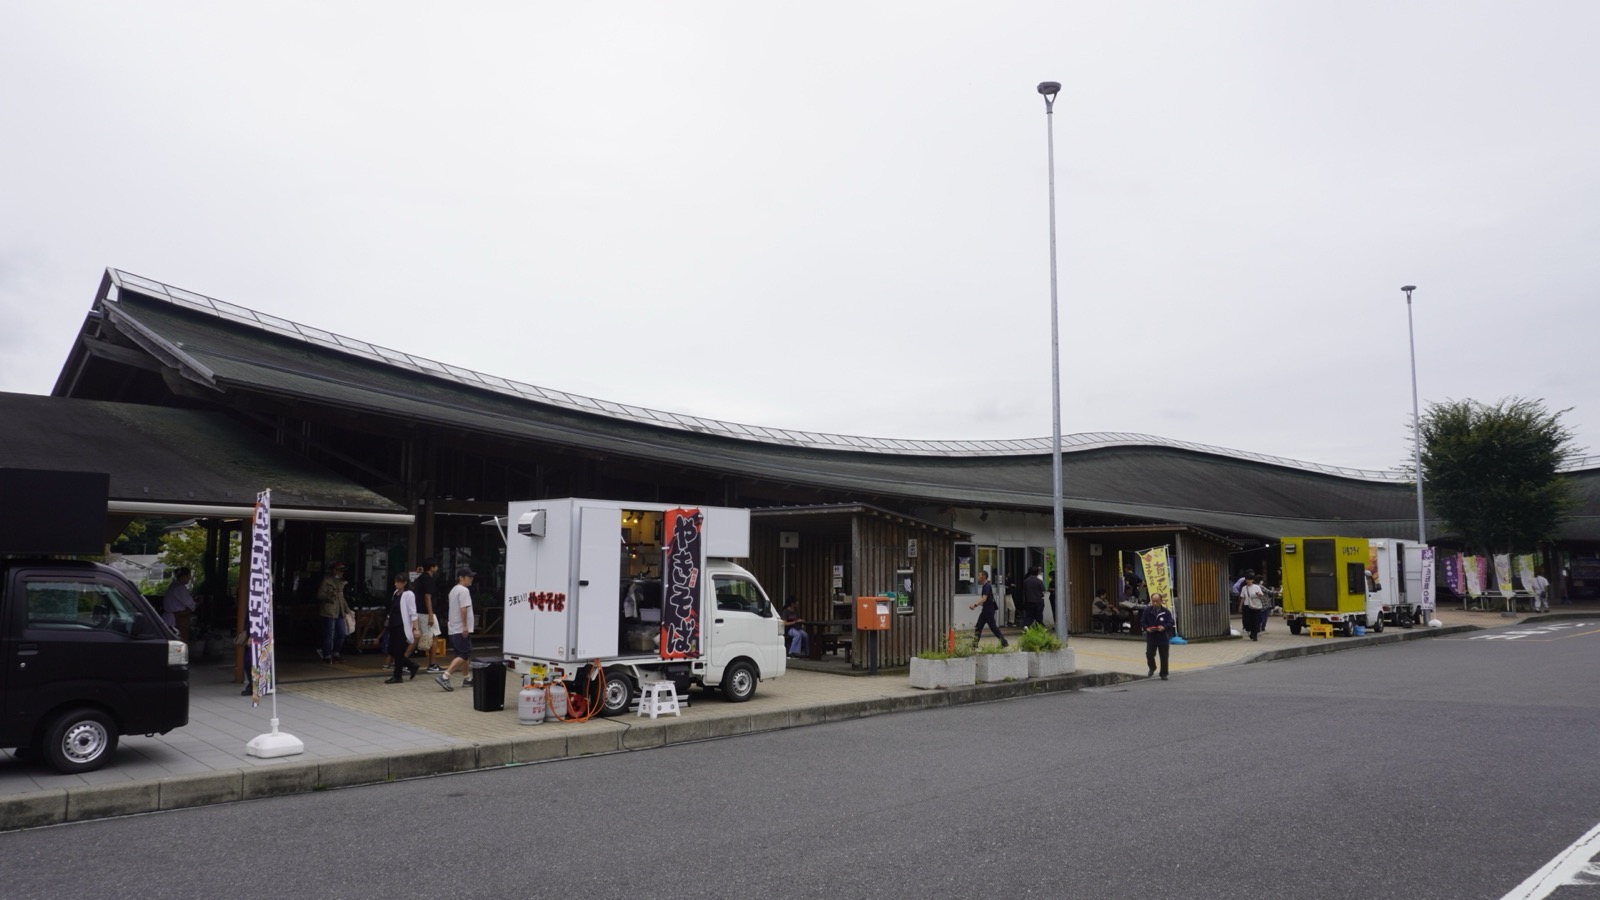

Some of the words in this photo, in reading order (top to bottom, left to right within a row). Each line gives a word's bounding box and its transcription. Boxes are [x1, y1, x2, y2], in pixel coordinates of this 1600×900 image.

[528, 591, 566, 612] やきそば
[667, 515, 698, 654] やきそば
